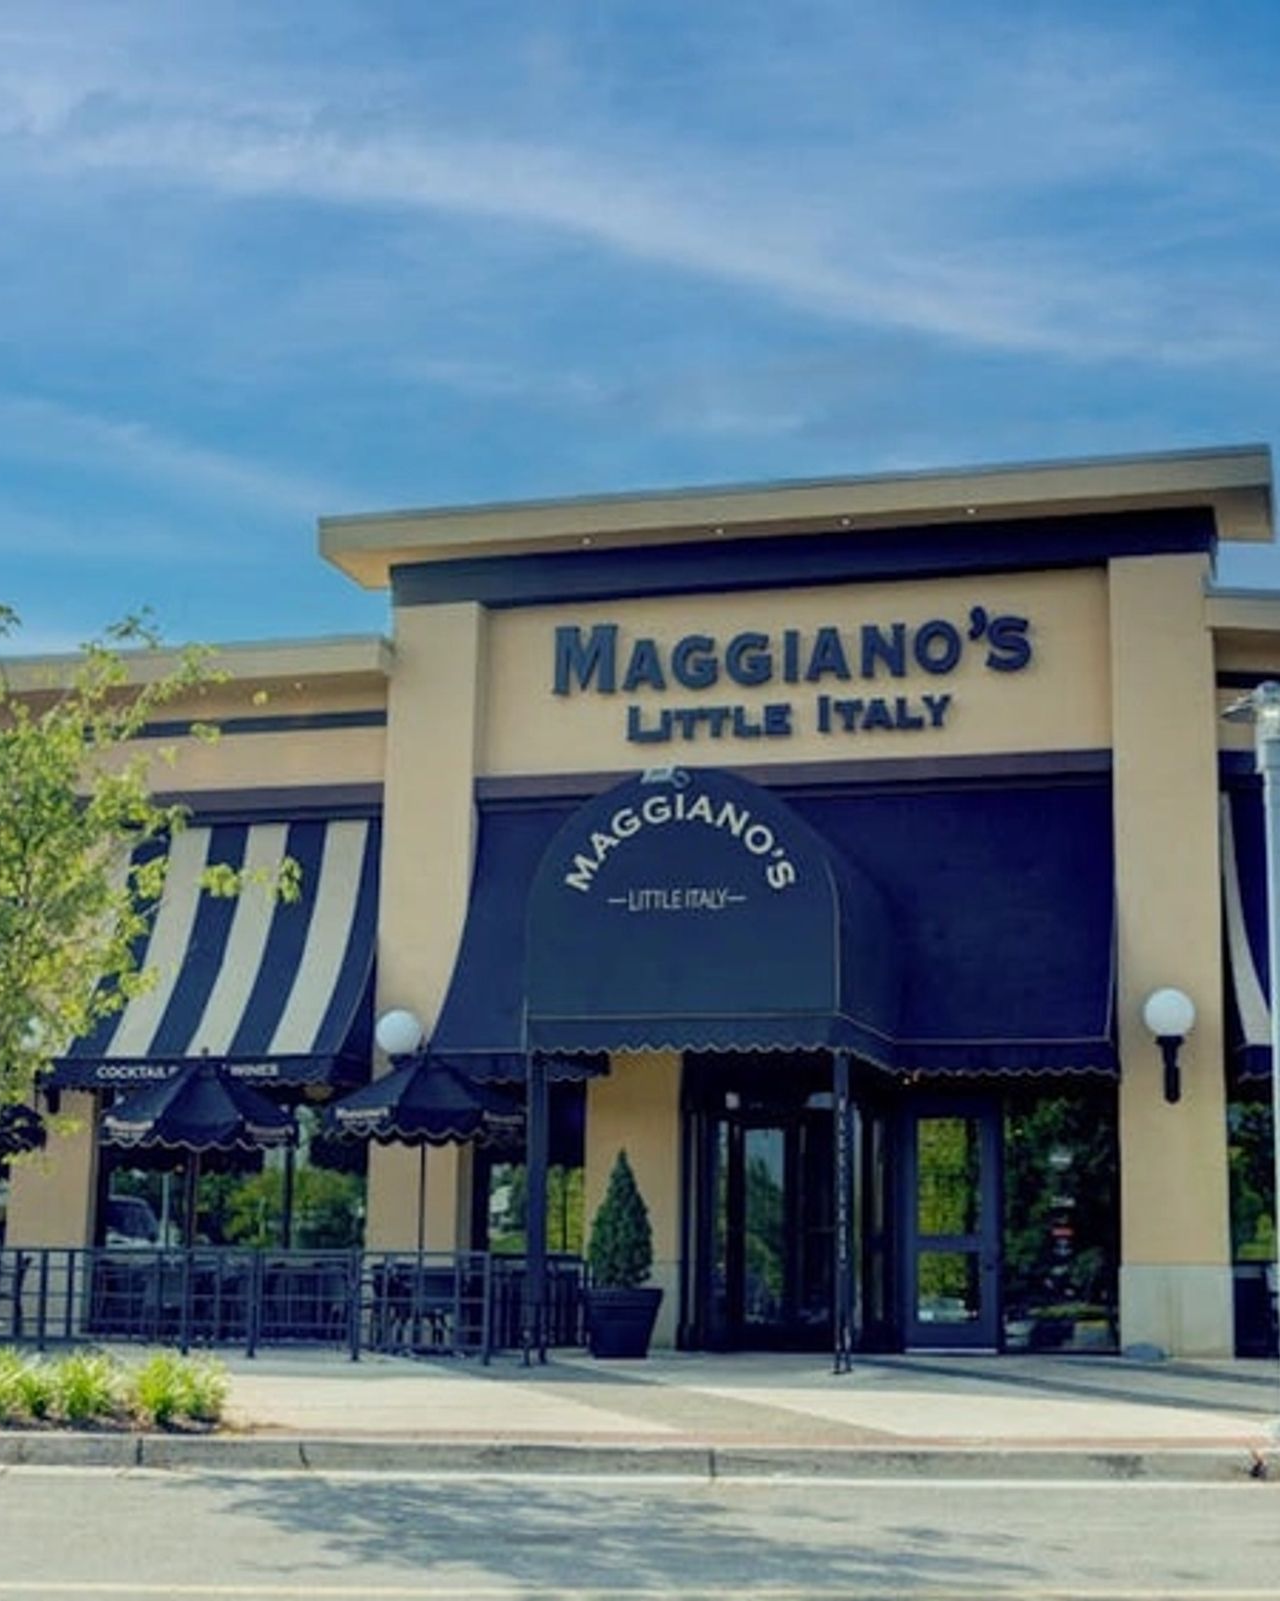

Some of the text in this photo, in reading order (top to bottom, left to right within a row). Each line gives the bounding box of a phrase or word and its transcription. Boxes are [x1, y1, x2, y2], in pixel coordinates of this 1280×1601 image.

[552, 605, 1033, 695] MAGGIANO'S
[625, 694, 953, 743] LITTLE ITALY
[565, 793, 796, 892] MAGGIANO'S
[628, 887, 729, 911] LITTLE ITALY
[230, 1063, 280, 1077] WINES
